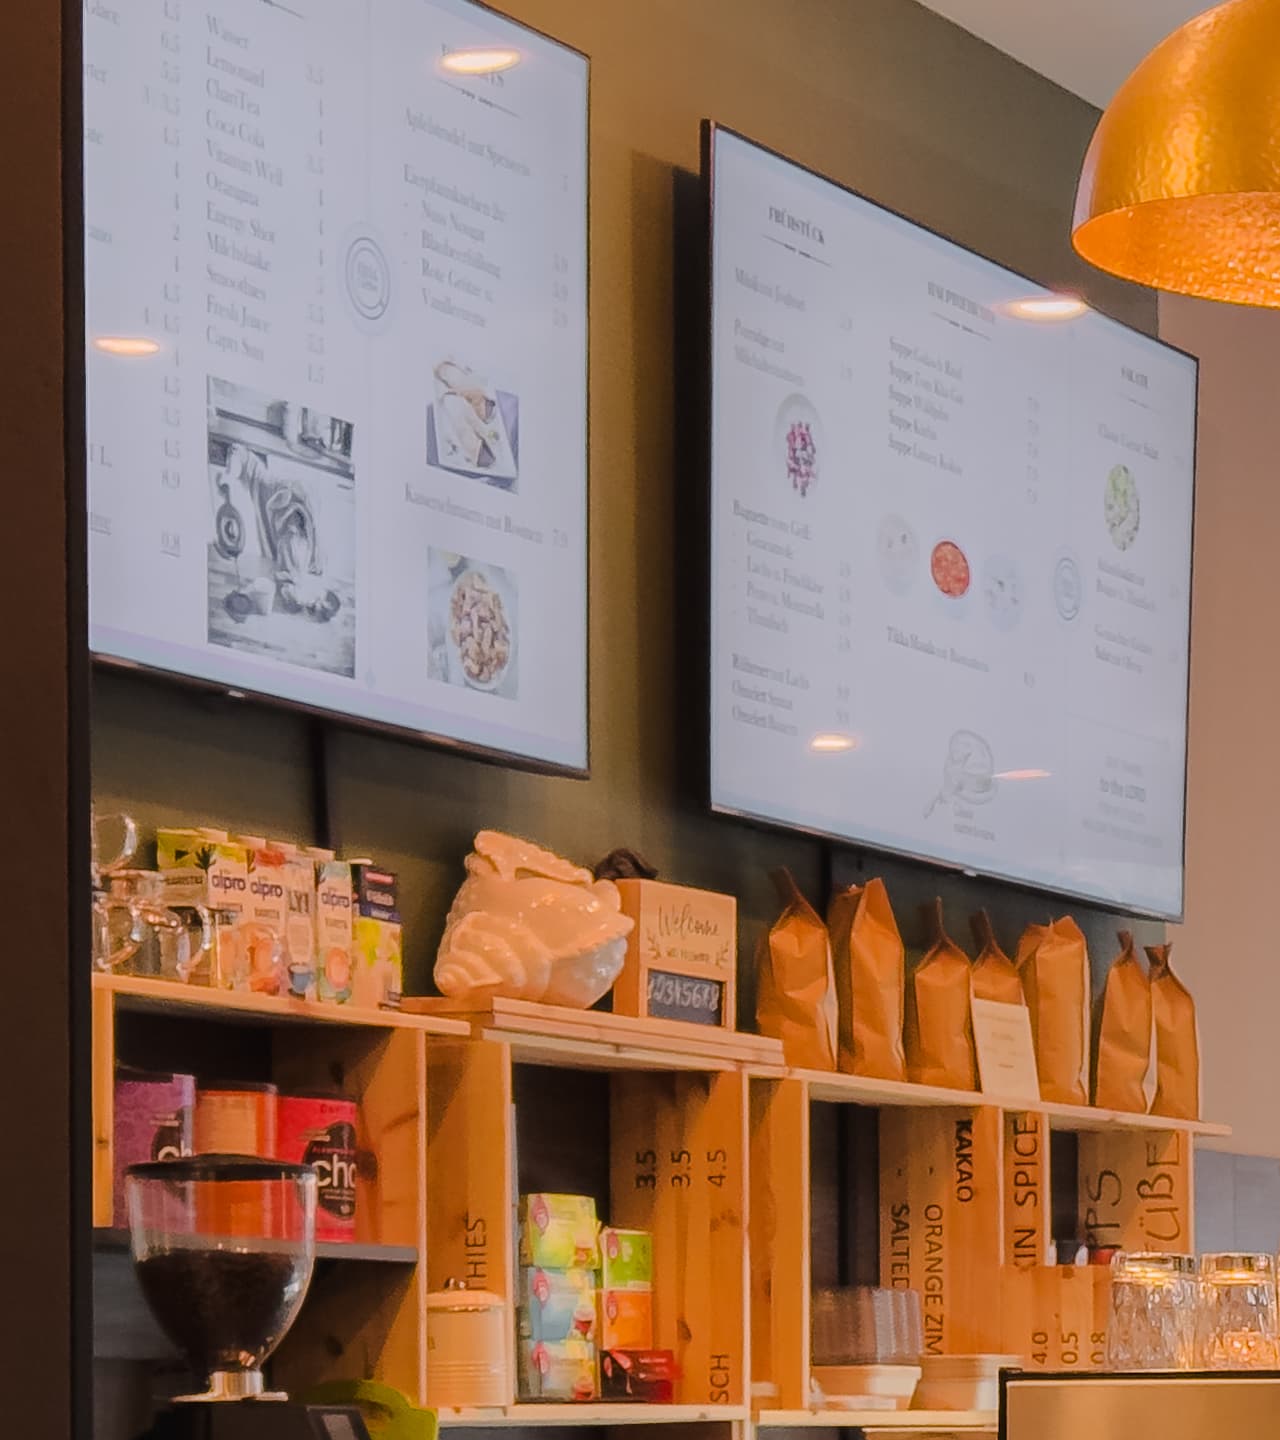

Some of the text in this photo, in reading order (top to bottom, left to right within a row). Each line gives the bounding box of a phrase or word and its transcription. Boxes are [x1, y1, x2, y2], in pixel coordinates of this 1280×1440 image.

[635, 1149, 658, 1190] 3.5
[671, 1149, 692, 1189] 3.5
[706, 1149, 728, 1189] 4.5
[954, 1118, 975, 1203] KAKAO
[1014, 1118, 1039, 1208] SPICE
[923, 1203, 944, 1306] ORANGE
[1032, 1331, 1049, 1365] 4.0
[1060, 1331, 1079, 1364] 0.5
